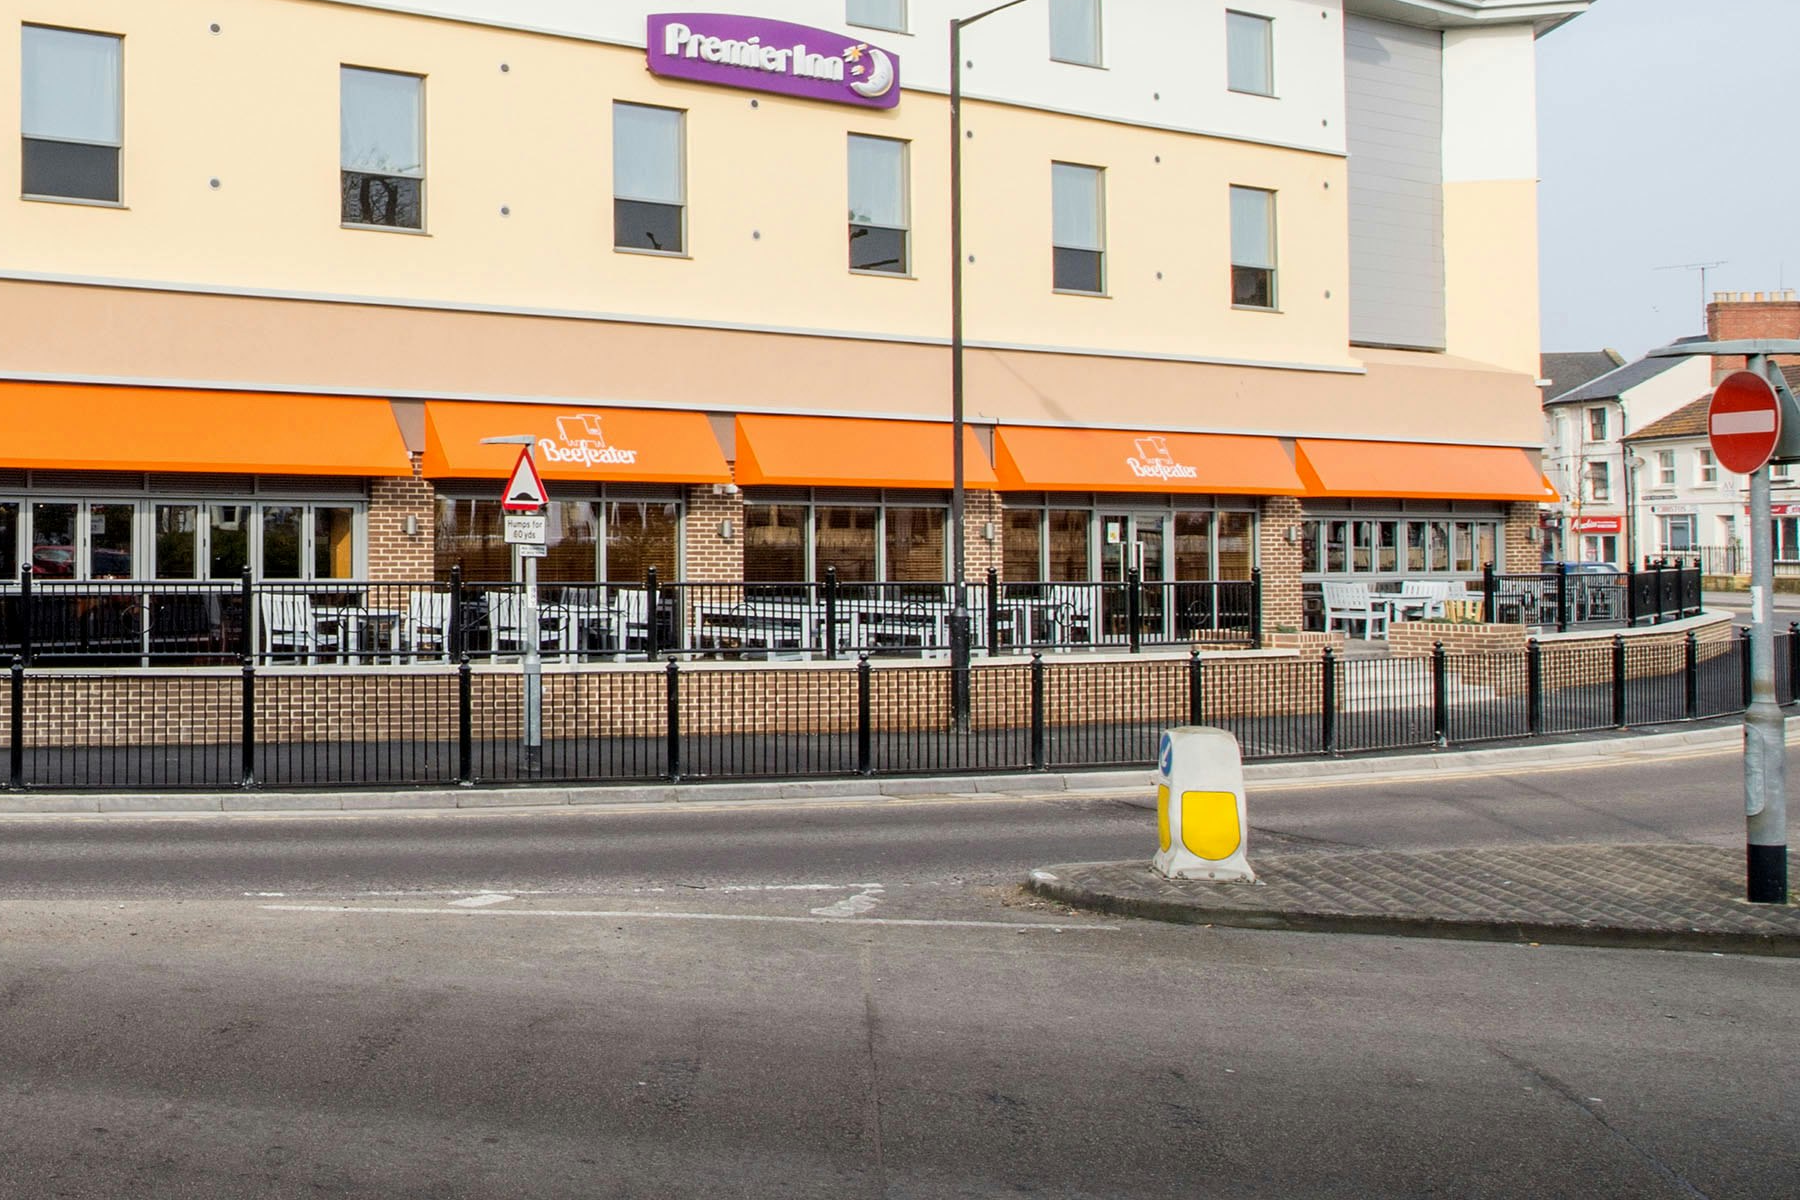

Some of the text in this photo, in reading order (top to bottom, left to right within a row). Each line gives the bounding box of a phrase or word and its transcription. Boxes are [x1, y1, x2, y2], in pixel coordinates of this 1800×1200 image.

[665, 23, 844, 81] Premier Inn
[538, 438, 638, 468] Beefeater
[1126, 457, 1198, 481] Beefeater
[507, 519, 543, 530] Humps for
[524, 531, 536, 541] yds
